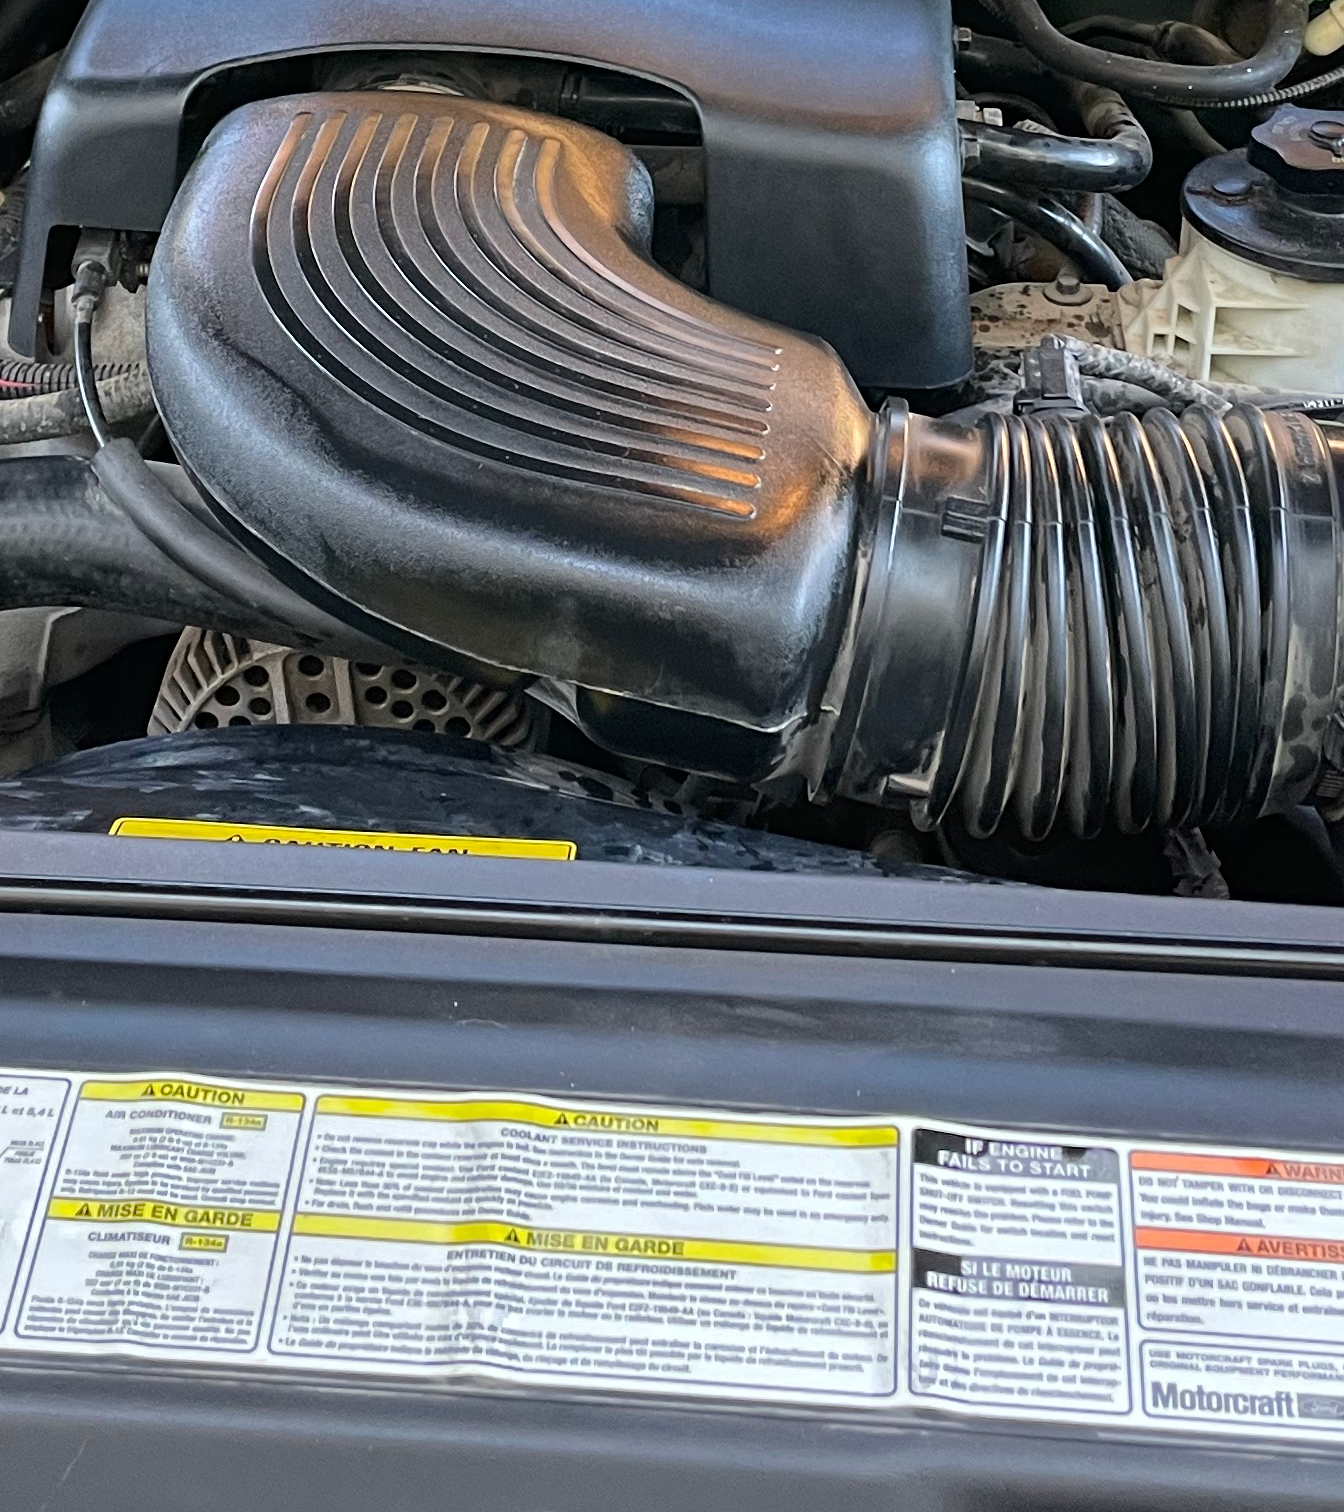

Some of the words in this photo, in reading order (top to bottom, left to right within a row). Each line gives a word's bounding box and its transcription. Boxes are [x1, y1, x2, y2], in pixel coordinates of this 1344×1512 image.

[13, 1086, 29, 1096] LA
[160, 1084, 245, 1104] CAUTION
[105, 1109, 126, 1119] AIR
[129, 1110, 212, 1125] CONDITIONER
[573, 1113, 659, 1132] CAUTION
[500, 1127, 558, 1144] COOLANT
[561, 1136, 613, 1148] SERVICE
[616, 1139, 707, 1153] INSTRUCTIONS
[964, 1138, 984, 1155] IF
[987, 1141, 1063, 1161] ENGINE
[937, 1149, 990, 1172] FAILS
[996, 1158, 1024, 1173] TO
[1029, 1160, 1091, 1178] START
[96, 1203, 146, 1218] MISE
[150, 1205, 178, 1221] EN
[184, 1209, 254, 1227] GARDE
[87, 1231, 171, 1246] CLIMATISEUR
[526, 1231, 575, 1249] MISE
[580, 1236, 610, 1251] EN
[614, 1238, 685, 1256] GARDE
[447, 1250, 516, 1264] ENTRETIEN
[519, 1256, 537, 1267] DU
[540, 1257, 592, 1270] CIRCUIT
[595, 1260, 613, 1272] DE
[617, 1262, 737, 1280] REFROIDISSEMENT
[960, 1259, 978, 1277] SI
[982, 1261, 1001, 1278] LE
[1005, 1264, 1072, 1283] MOTEUR
[926, 1270, 988, 1295] REFUSE
[992, 1280, 1013, 1296] DE
[1150, 1380, 1296, 1418] Motorcraft
